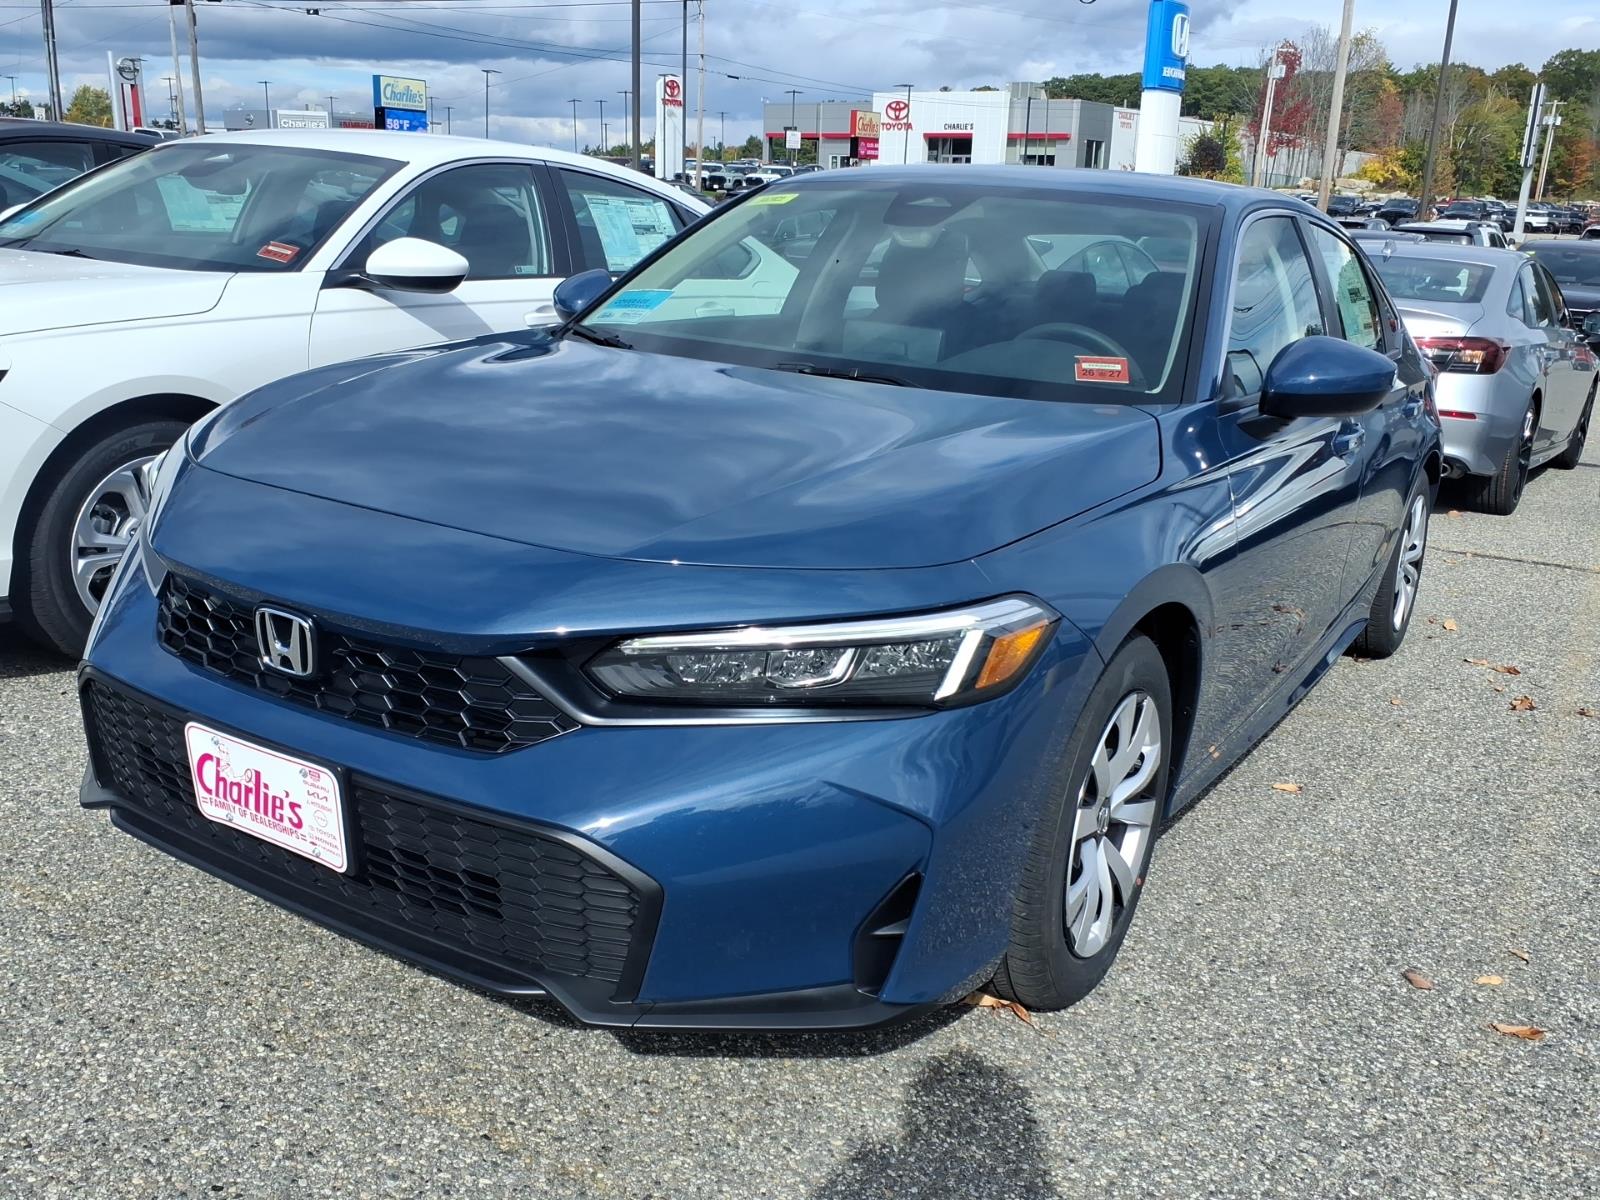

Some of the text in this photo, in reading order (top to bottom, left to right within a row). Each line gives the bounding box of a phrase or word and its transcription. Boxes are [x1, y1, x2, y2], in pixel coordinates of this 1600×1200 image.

[383, 83, 424, 104] Charlie's
[881, 122, 913, 131] TOYOTA
[943, 123, 974, 131] CHARLIE'S
[1082, 369, 1121, 378] 26 27
[197, 753, 303, 829] Charlie's
[209, 797, 236, 814] FAMILY
[239, 808, 248, 819] OF
[250, 811, 300, 840] DEALERSHIPS
